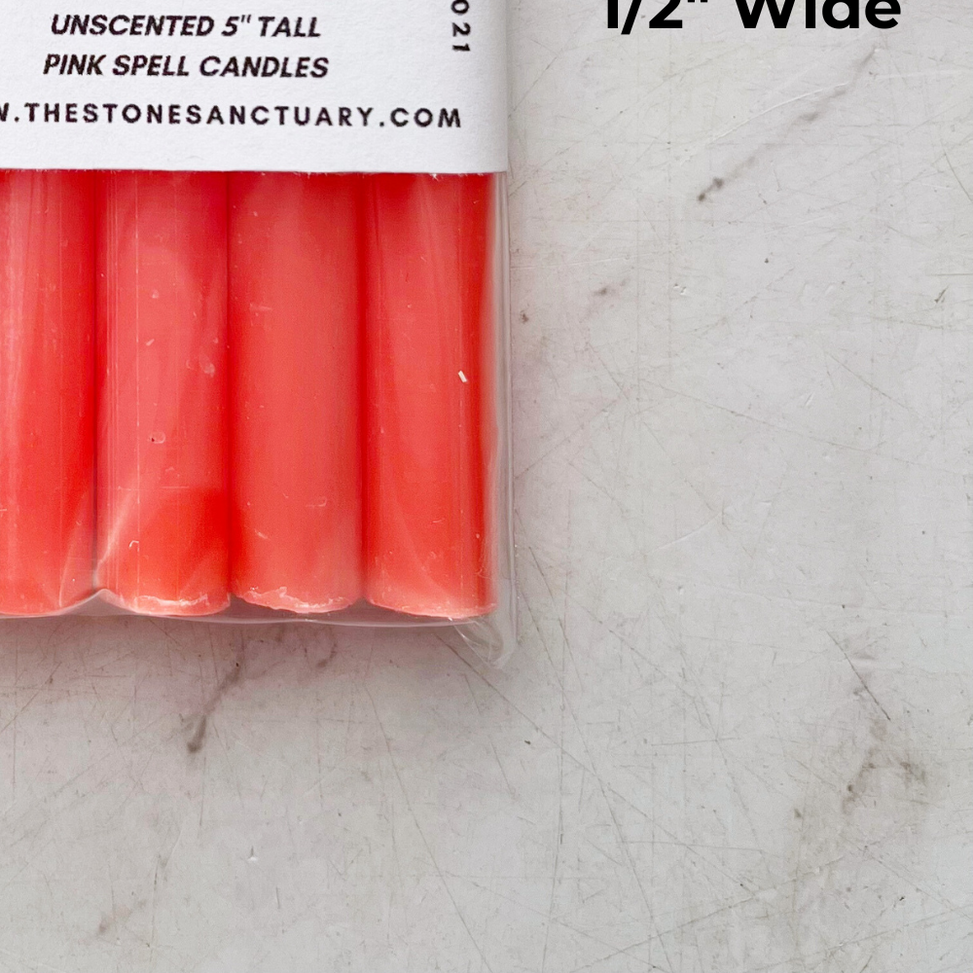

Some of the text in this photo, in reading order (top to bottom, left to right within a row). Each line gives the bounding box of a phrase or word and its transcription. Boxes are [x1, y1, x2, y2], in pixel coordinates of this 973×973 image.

[50, 13, 215, 37] UNSCENTED
[258, 16, 322, 38] TALL
[43, 53, 330, 78] PINK SPELL CANDLES
